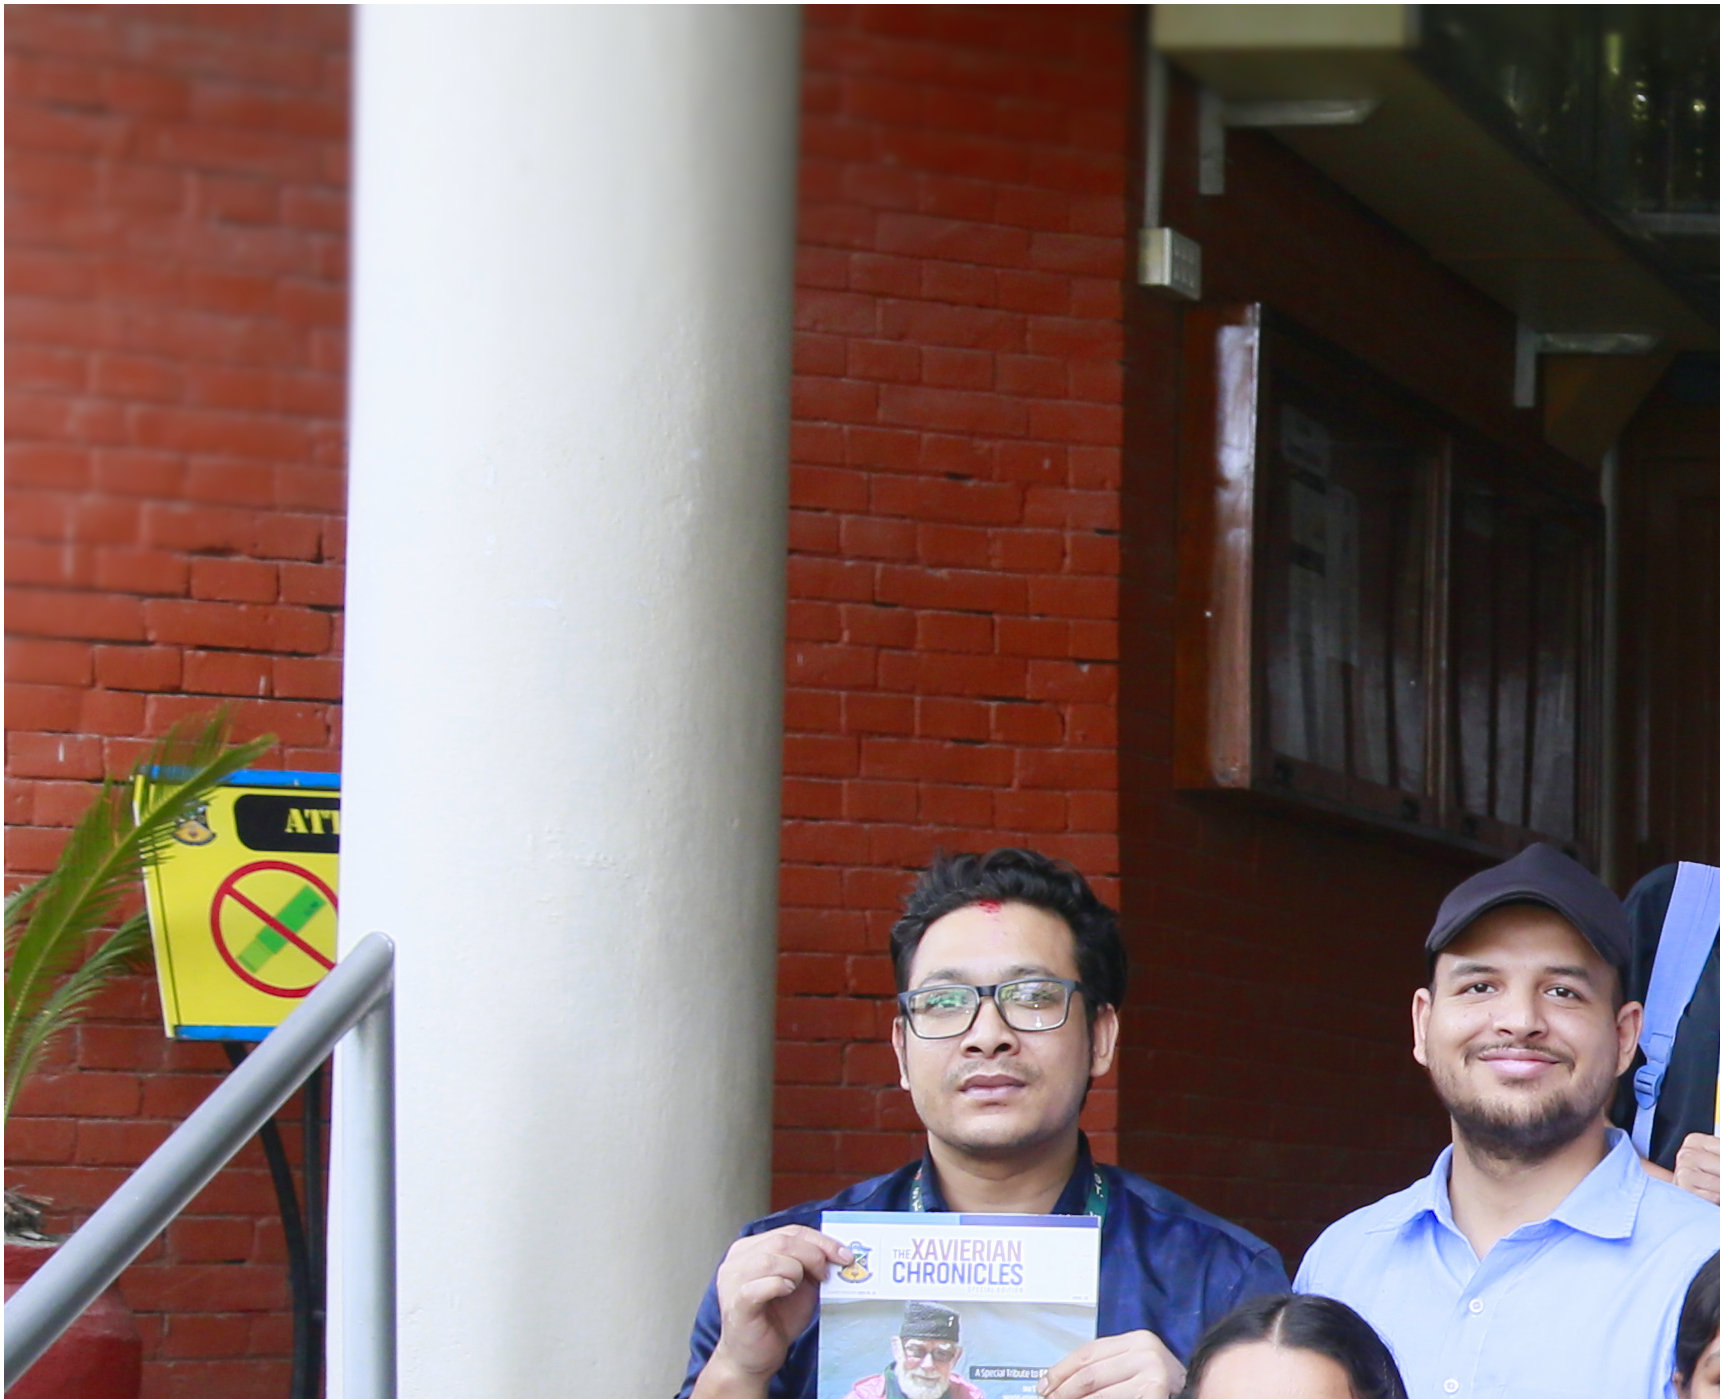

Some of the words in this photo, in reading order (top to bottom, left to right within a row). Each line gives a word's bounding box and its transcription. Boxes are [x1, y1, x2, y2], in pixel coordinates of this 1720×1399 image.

[893, 1248, 911, 1259] THE
[911, 1238, 1022, 1262] XAVIERIAN
[892, 1262, 1024, 1285] CHRONICLES
[975, 1369, 980, 1377] A
[981, 1368, 1005, 1379] Special
[1006, 1369, 1028, 1378] Tribute
[1029, 1369, 1038, 1378] to
